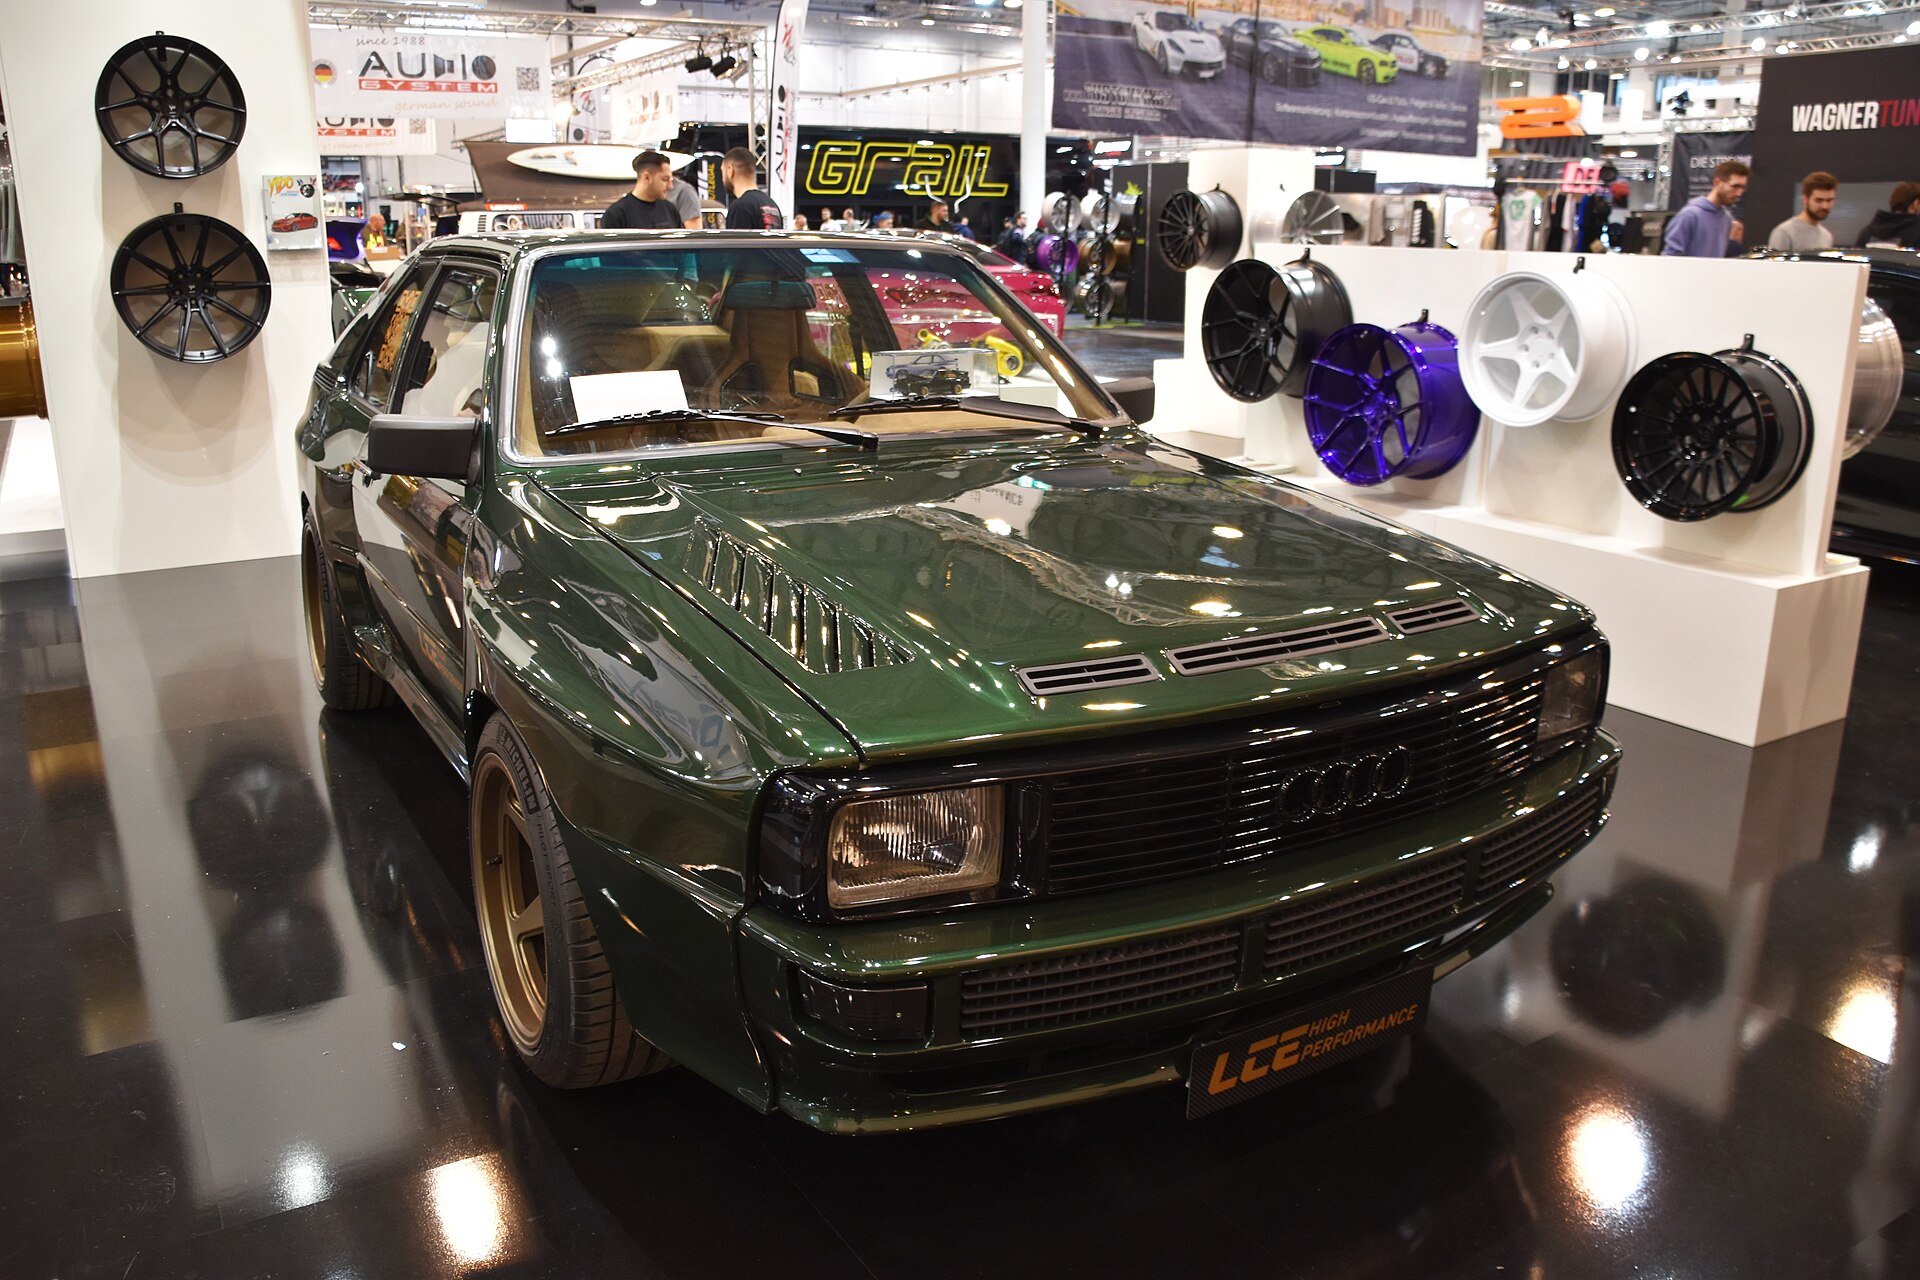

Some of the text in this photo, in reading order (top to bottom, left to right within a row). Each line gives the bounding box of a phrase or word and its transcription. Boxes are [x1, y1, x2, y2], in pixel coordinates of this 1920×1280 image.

[356, 36, 425, 46] since 1988
[503, 736, 538, 812] MICHELIN
[1300, 1004, 1418, 1062] PERFORMANCE
[1308, 1009, 1350, 1038] HIGH
